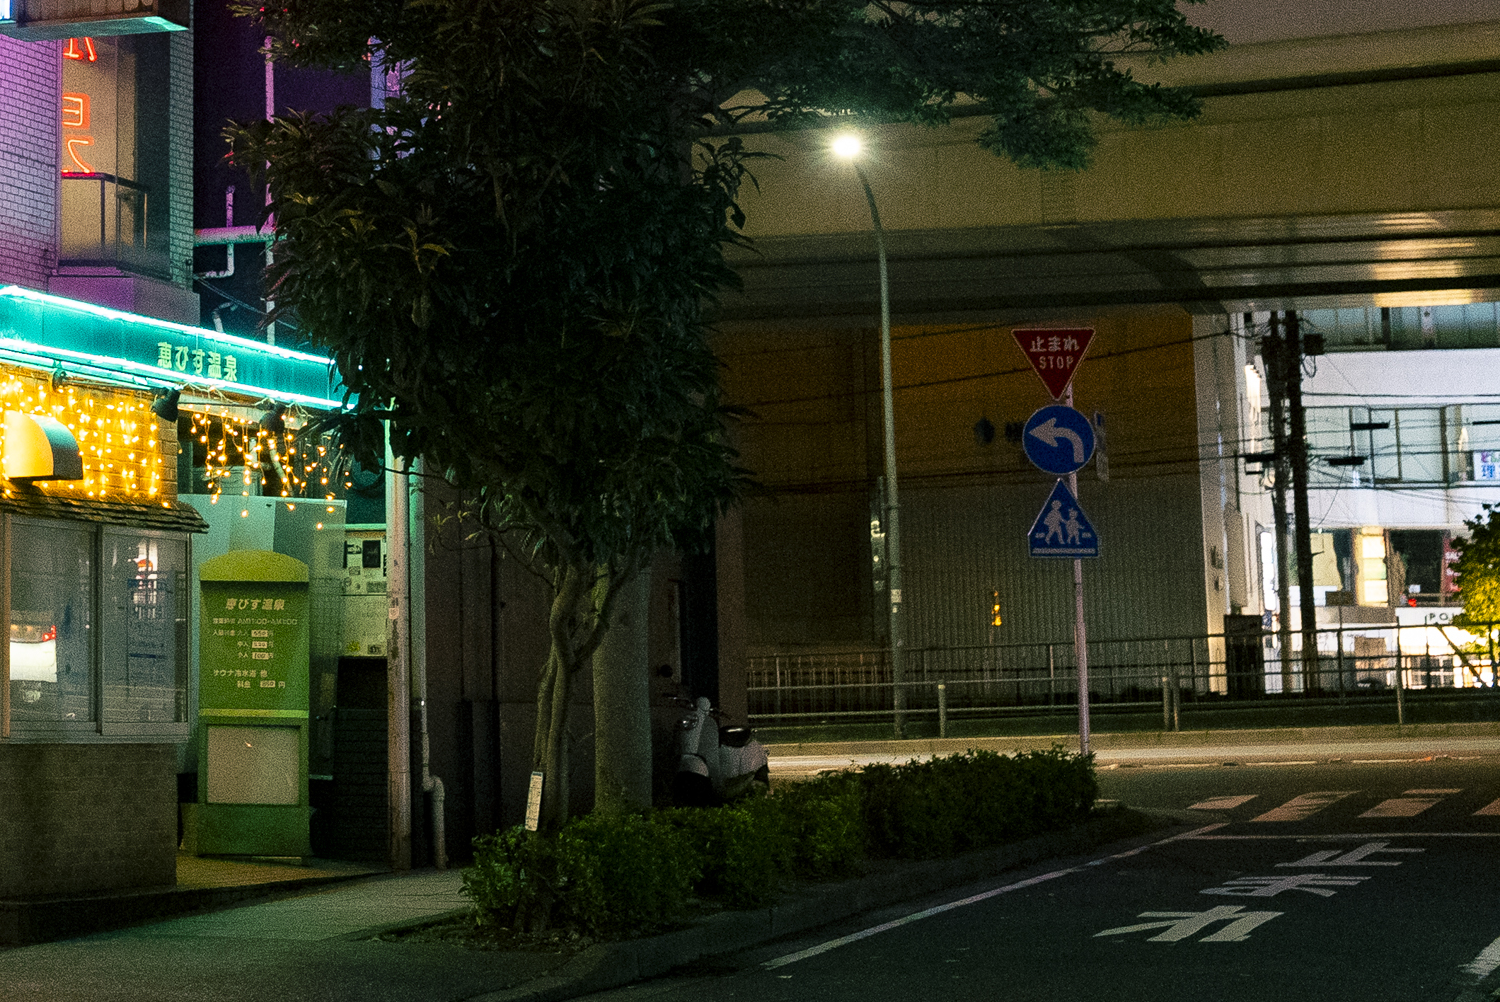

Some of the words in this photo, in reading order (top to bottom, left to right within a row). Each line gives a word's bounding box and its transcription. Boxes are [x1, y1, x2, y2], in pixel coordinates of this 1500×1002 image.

[1029, 335, 1080, 353] 止まれ
[157, 341, 238, 382] 恵びす温泉
[1039, 355, 1074, 370] STOP
[225, 598, 285, 611] 恵びす温泉
